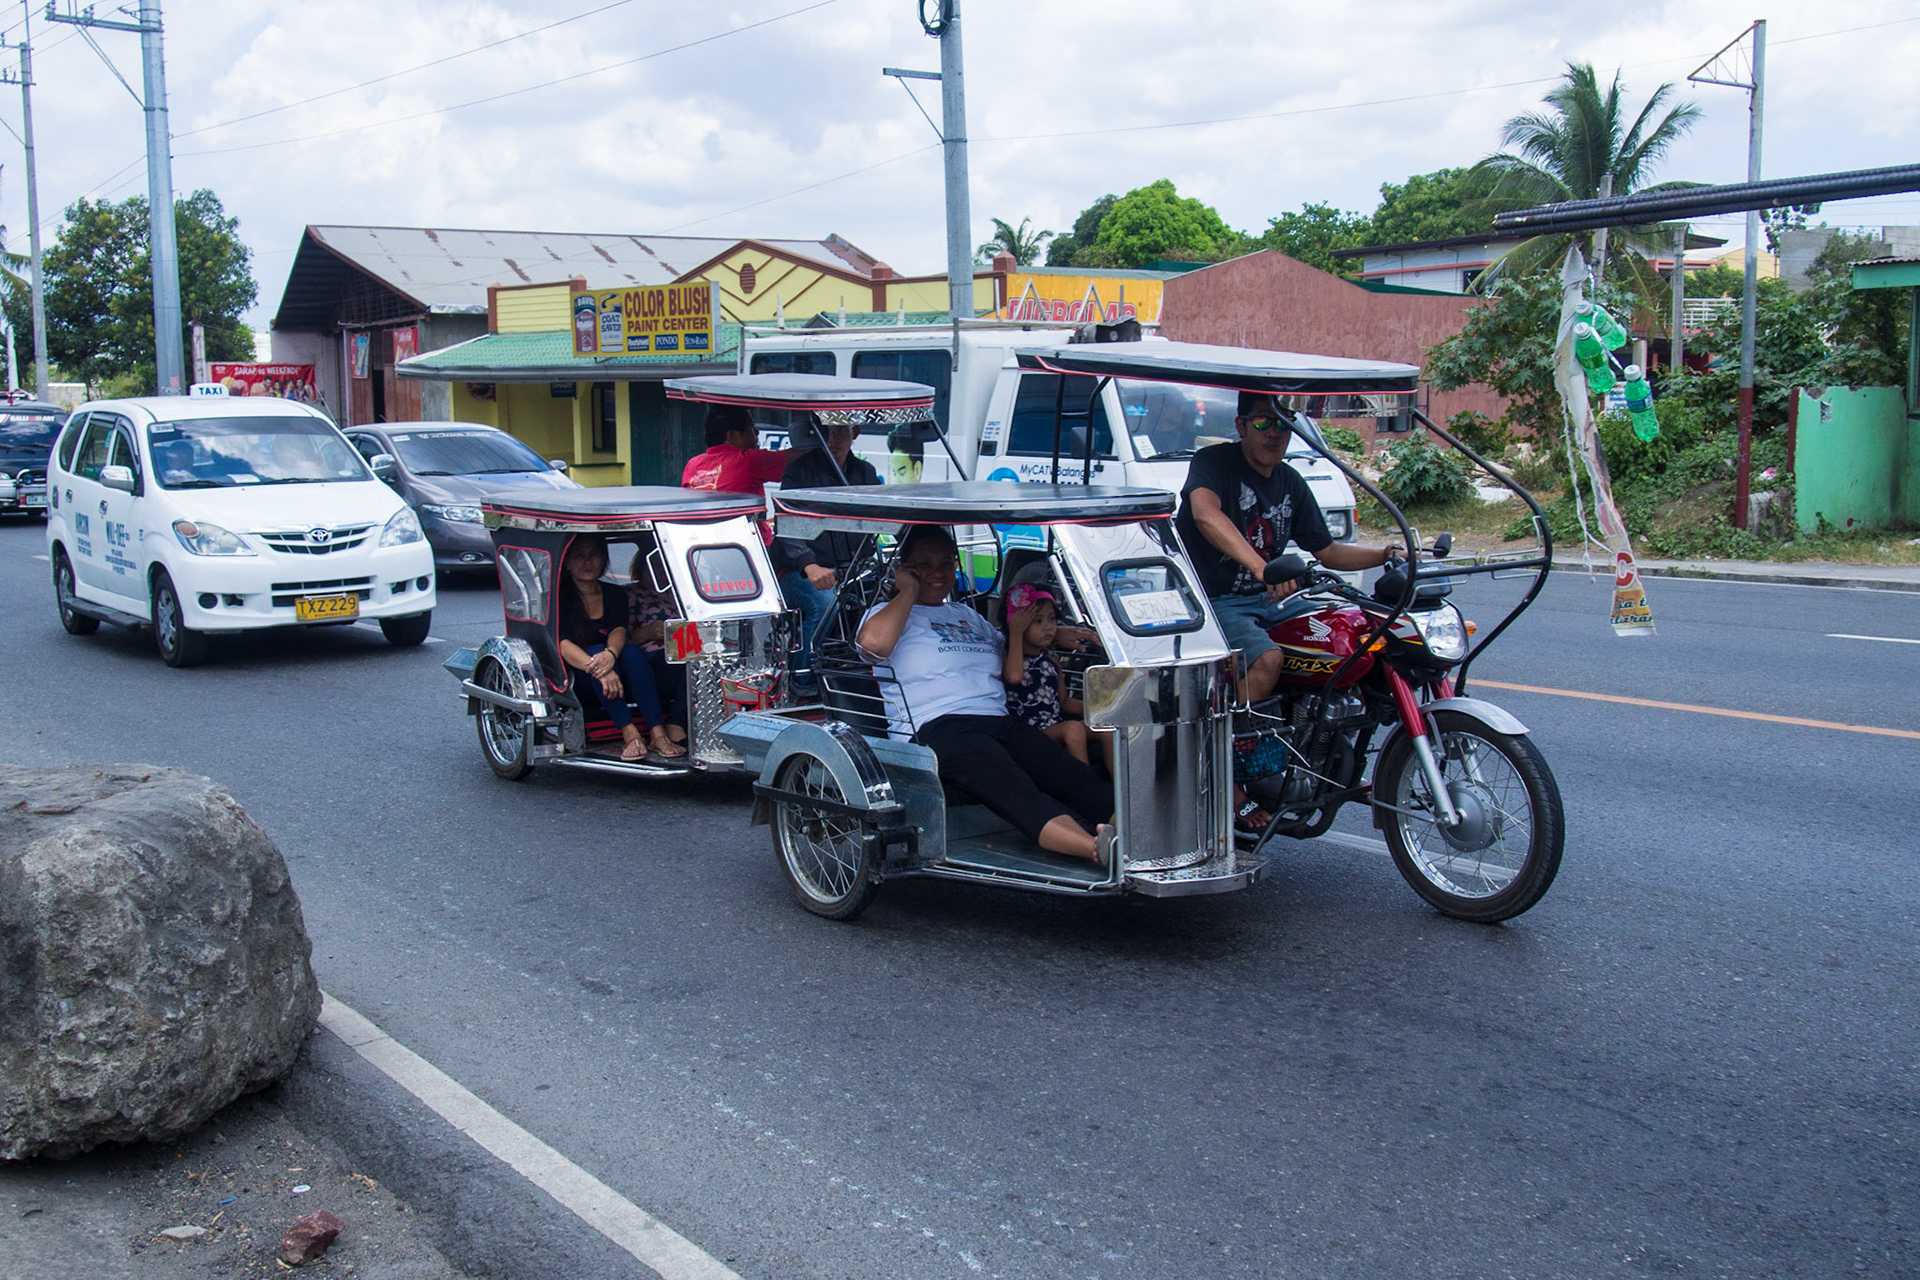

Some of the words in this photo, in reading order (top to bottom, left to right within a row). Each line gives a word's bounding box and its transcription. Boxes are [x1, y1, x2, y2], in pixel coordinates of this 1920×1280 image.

[624, 290, 664, 318] COLOR
[668, 287, 710, 315] BLUSH
[602, 315, 620, 323] COAT
[601, 323, 622, 332] SAVER
[627, 318, 660, 332] PAINT
[662, 316, 709, 330] CENTER
[234, 366, 257, 375] SARAP
[198, 387, 223, 395] TAXI
[702, 580, 756, 594] SERVICE
[671, 621, 703, 660] 14
[1303, 635, 1331, 643] HONDA
[937, 645, 961, 653] BOYET
[1281, 656, 1341, 674] TMX
